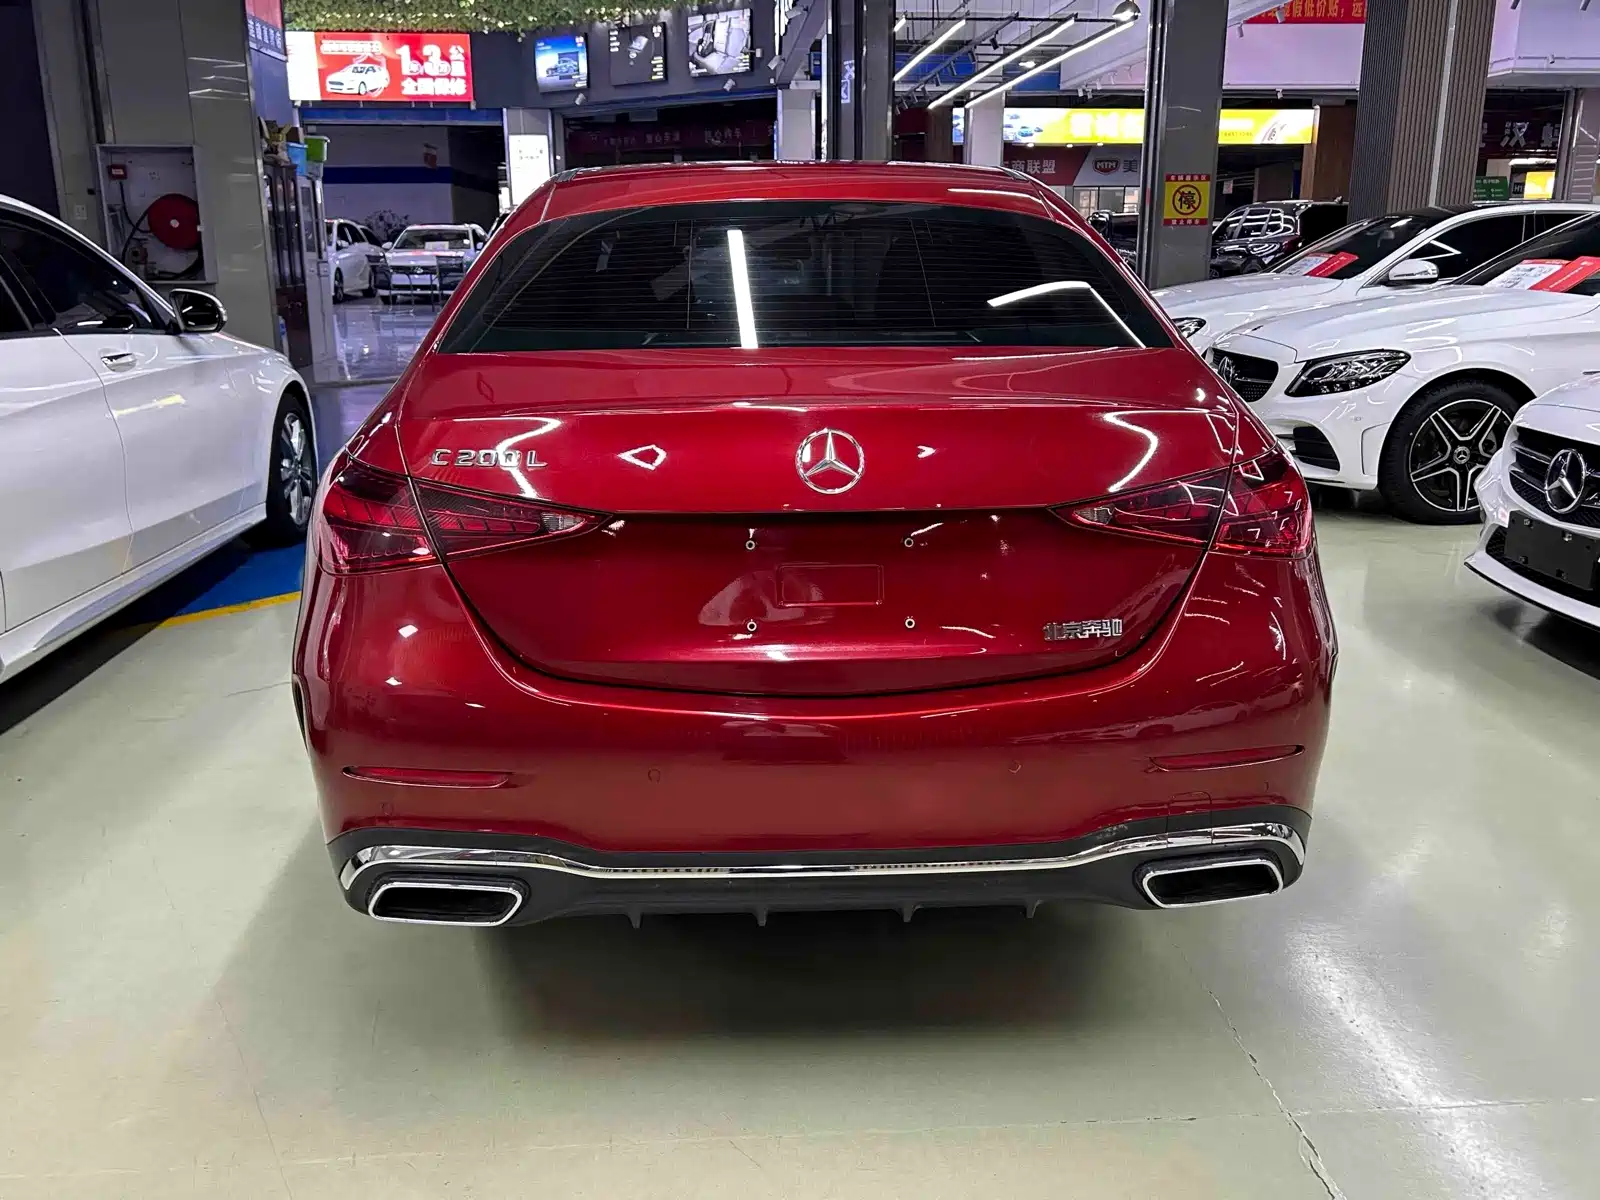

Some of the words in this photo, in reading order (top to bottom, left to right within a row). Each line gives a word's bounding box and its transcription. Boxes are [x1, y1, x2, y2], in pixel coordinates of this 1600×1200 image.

[1096, 161, 1117, 169] MTM
[1123, 159, 1138, 173] 美
[1178, 190, 1196, 210] 停
[1042, 618, 1123, 641] 北京奔驰
